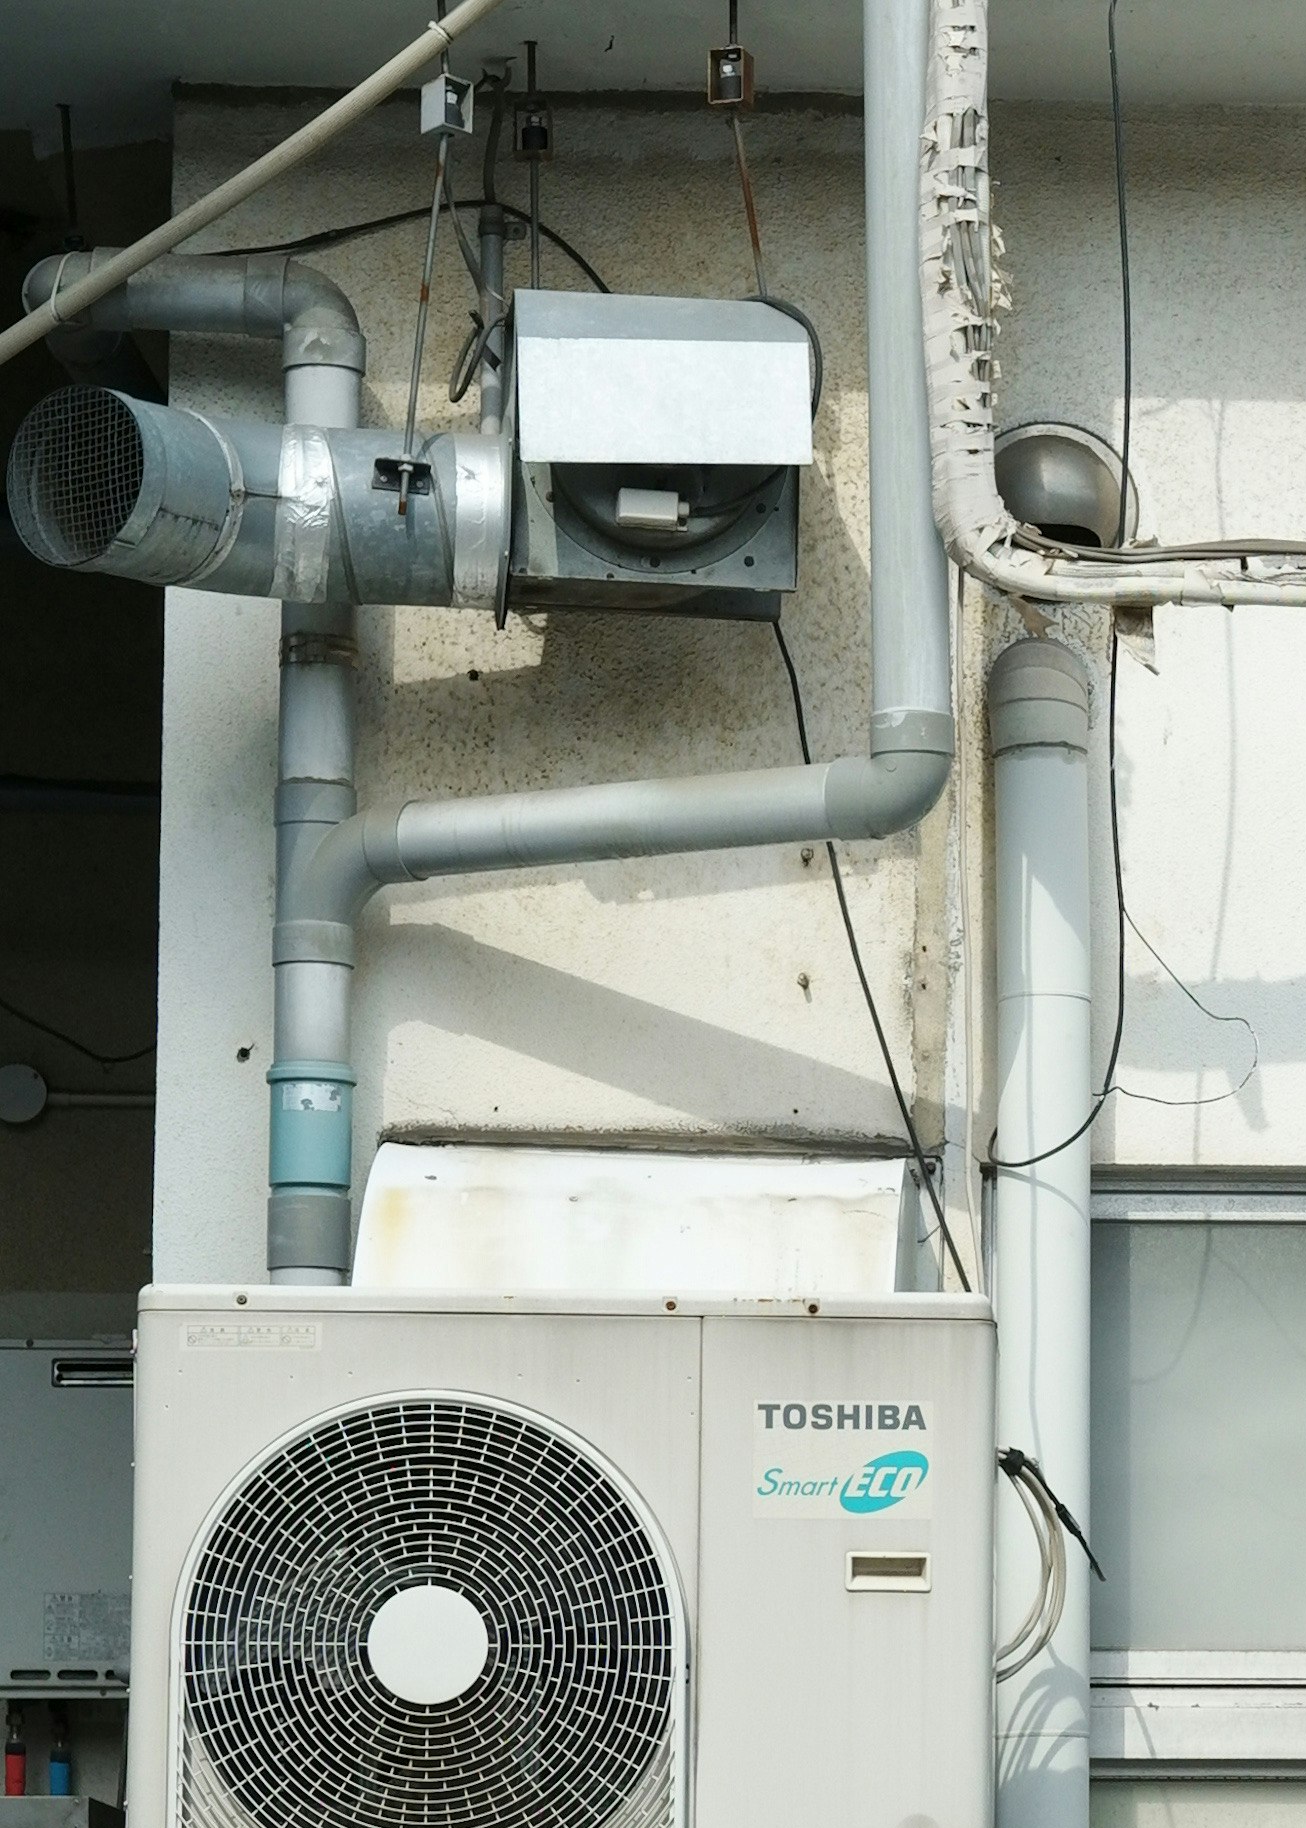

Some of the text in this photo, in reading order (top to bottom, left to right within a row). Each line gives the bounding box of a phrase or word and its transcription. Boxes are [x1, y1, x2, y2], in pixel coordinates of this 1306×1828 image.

[757, 1403, 927, 1430] TOSHIBA
[757, 1466, 924, 1498] Smart ECO
